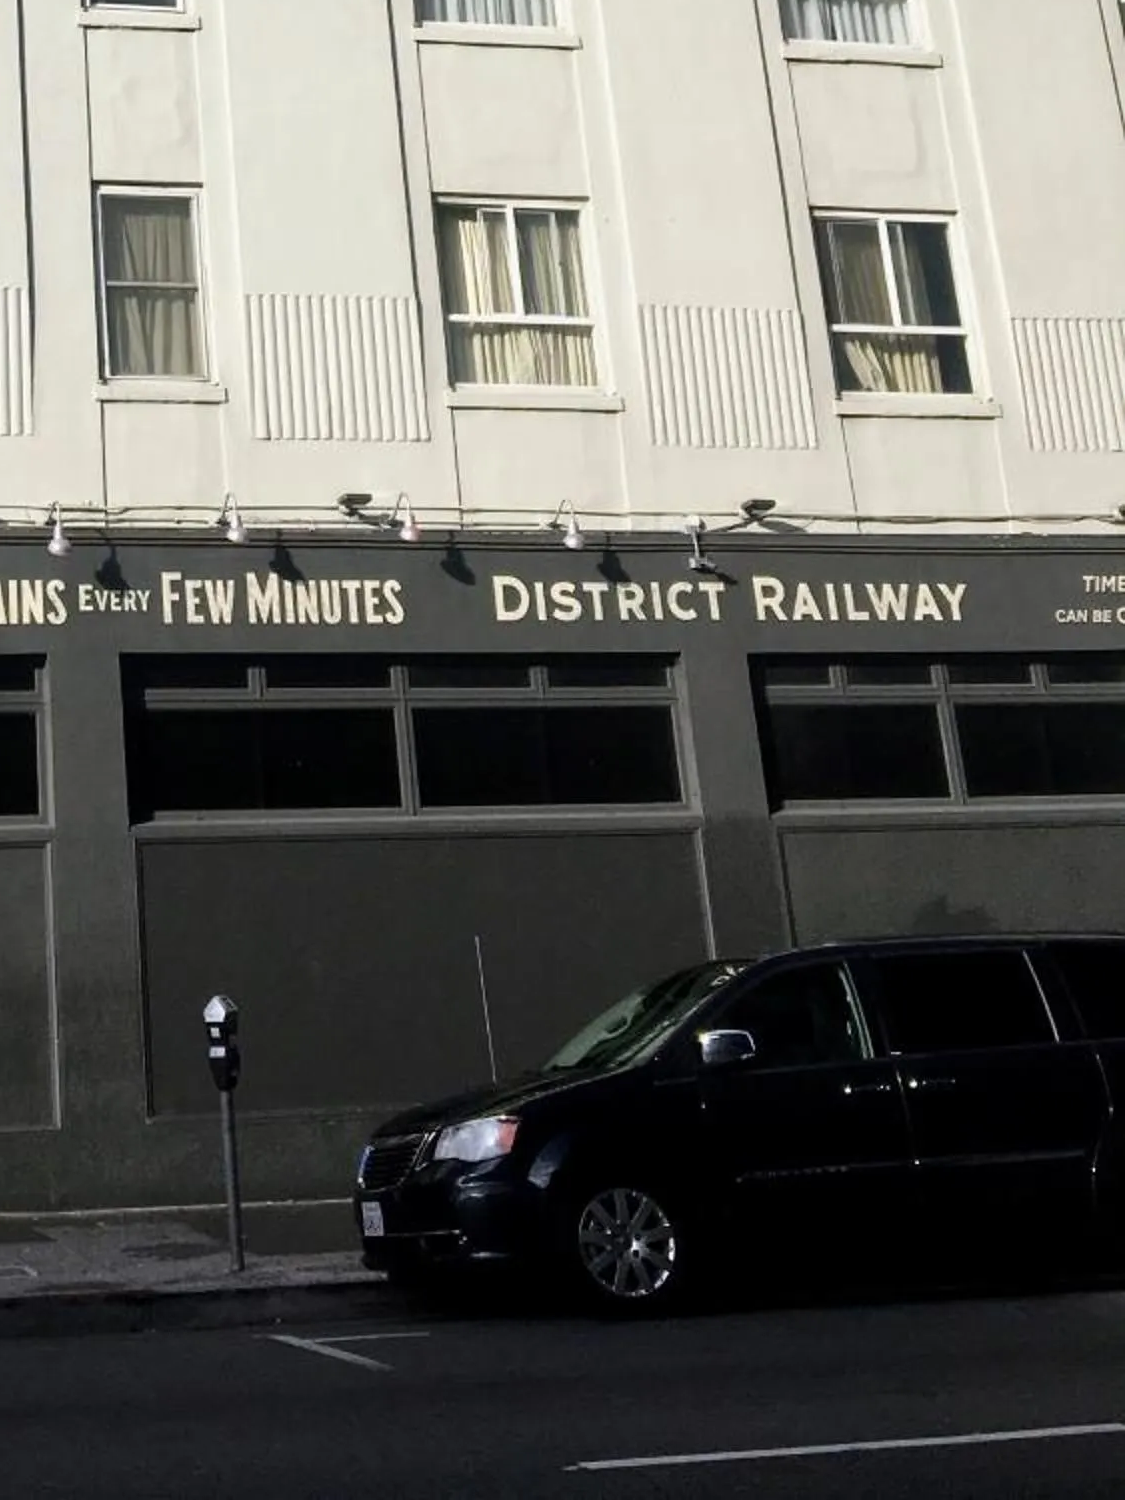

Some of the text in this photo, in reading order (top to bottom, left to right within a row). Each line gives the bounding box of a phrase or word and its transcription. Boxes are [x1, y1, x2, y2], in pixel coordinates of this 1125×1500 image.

[78, 583, 150, 612] EVERY
[160, 571, 235, 624] FEW
[246, 571, 405, 625] MINUTES
[492, 574, 967, 622] DISTRICT RAILWAY
[1055, 609, 1088, 623] CAN
[1092, 609, 1113, 623] BE
